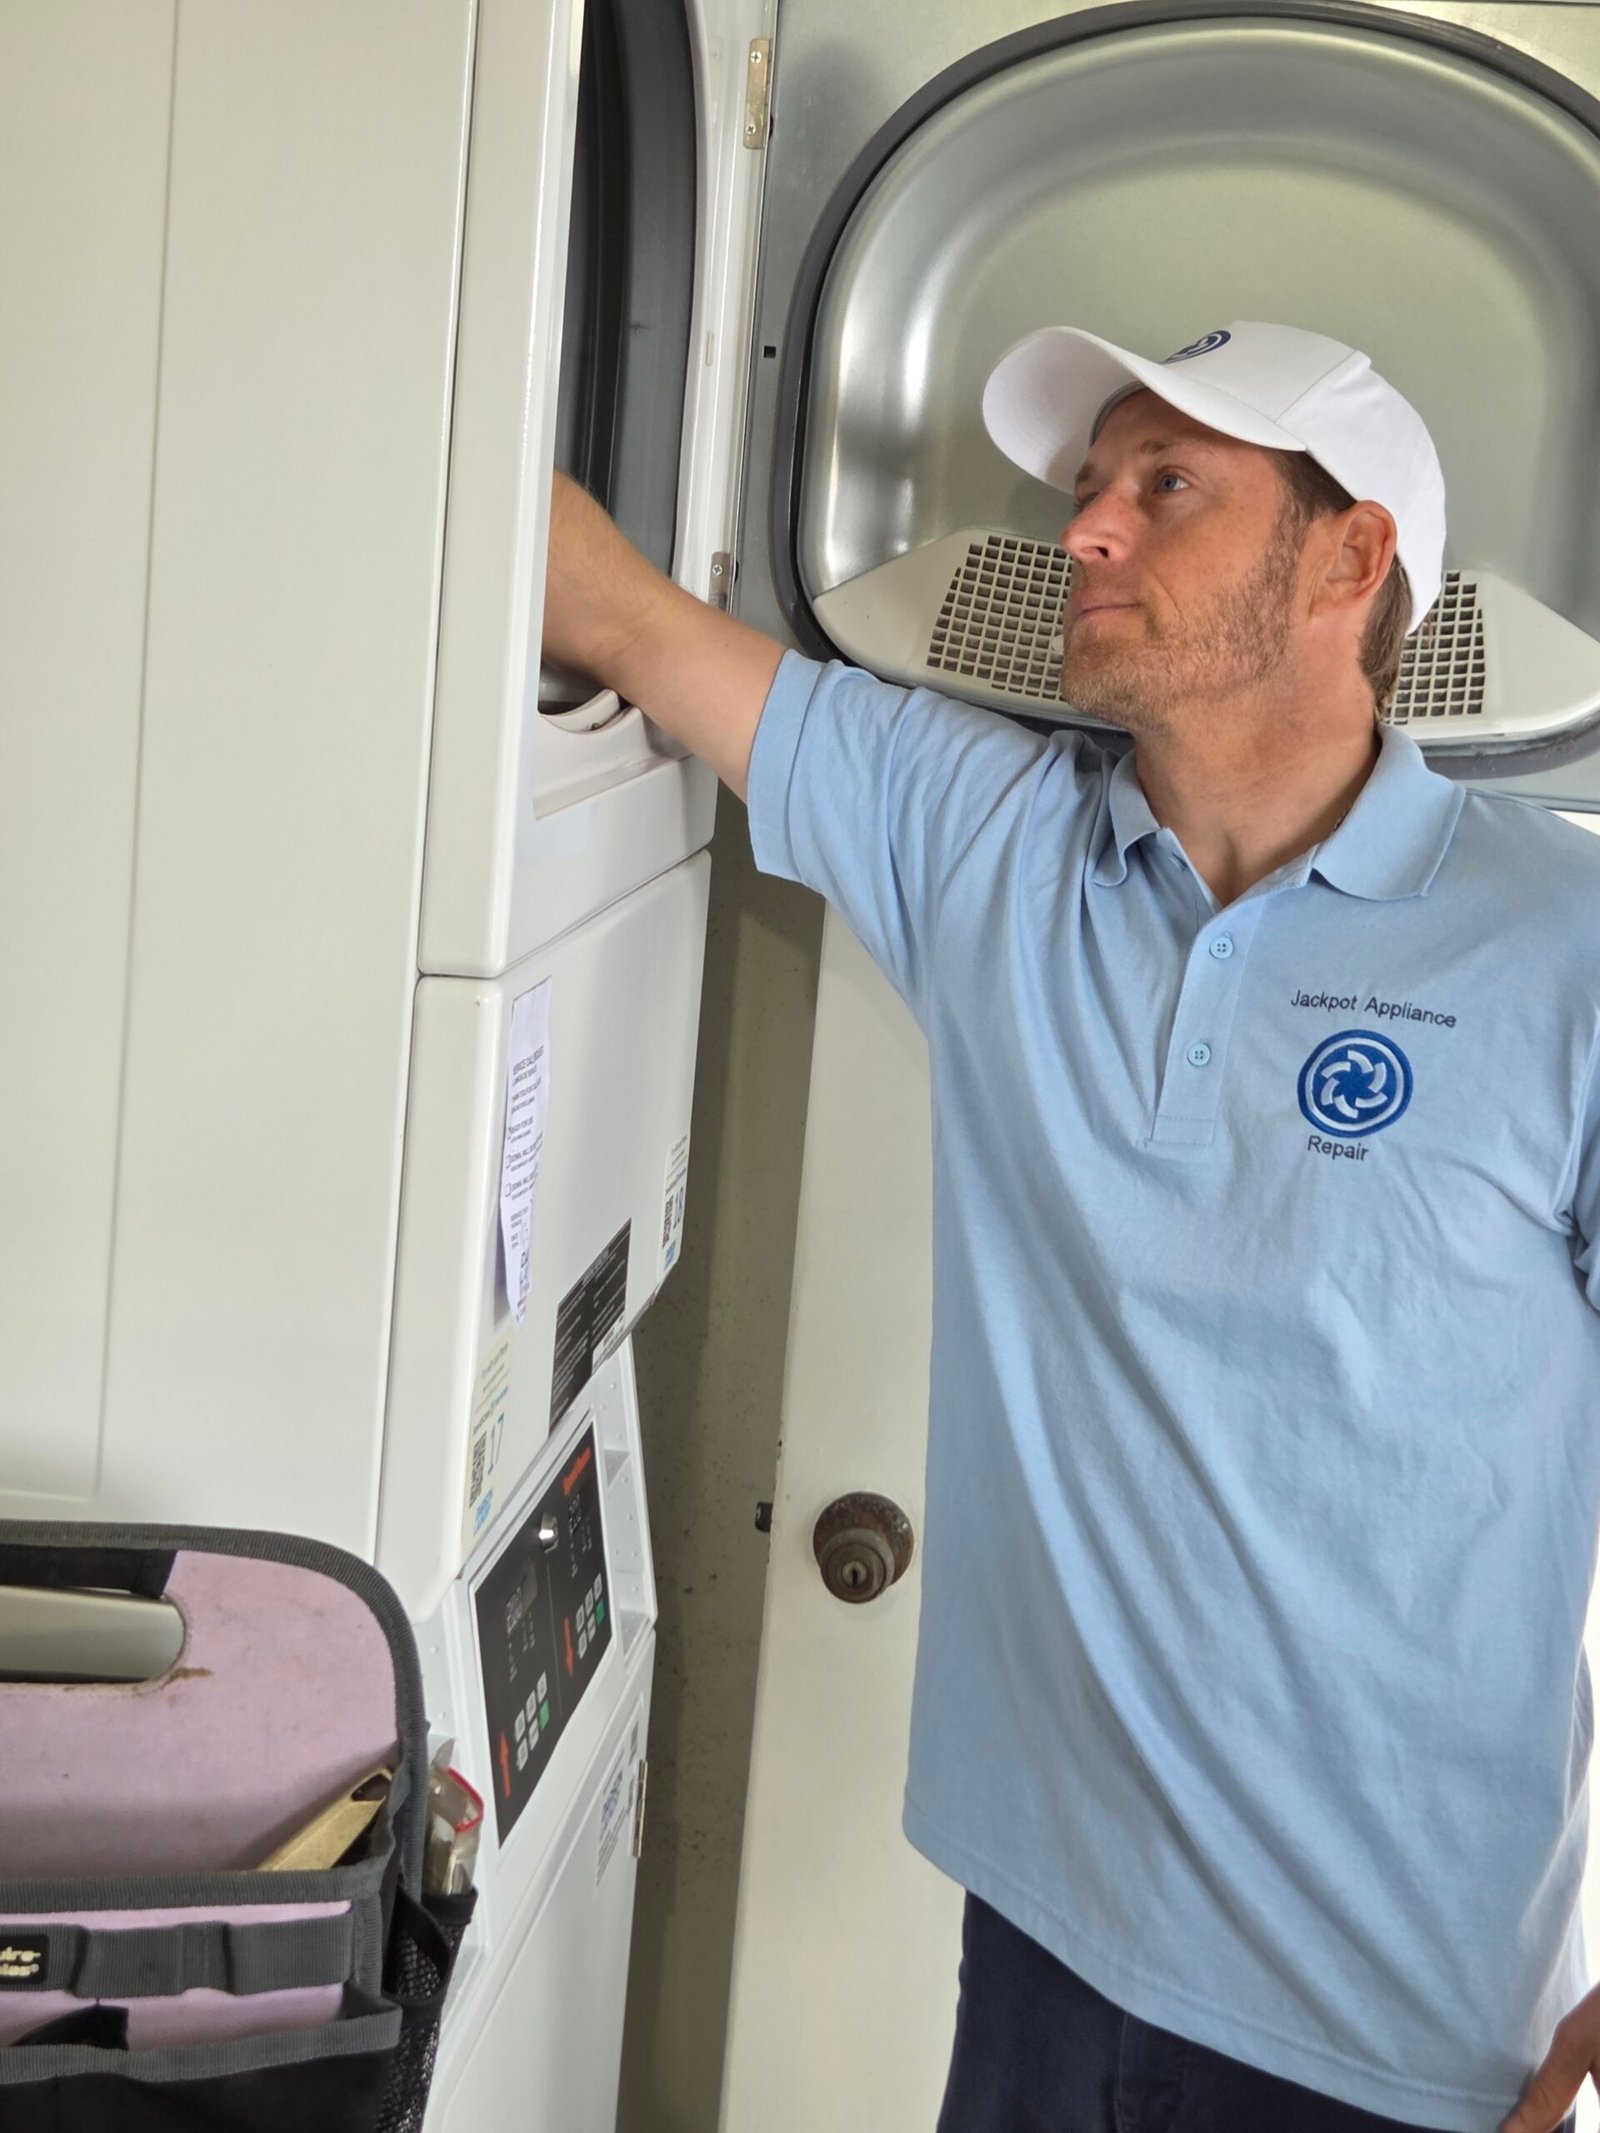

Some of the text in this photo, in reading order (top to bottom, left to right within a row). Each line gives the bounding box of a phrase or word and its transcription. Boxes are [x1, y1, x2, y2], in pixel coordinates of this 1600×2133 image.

[1290, 989, 1457, 1028] Jackpot Appliance
[1307, 1135, 1369, 1161] Repair
